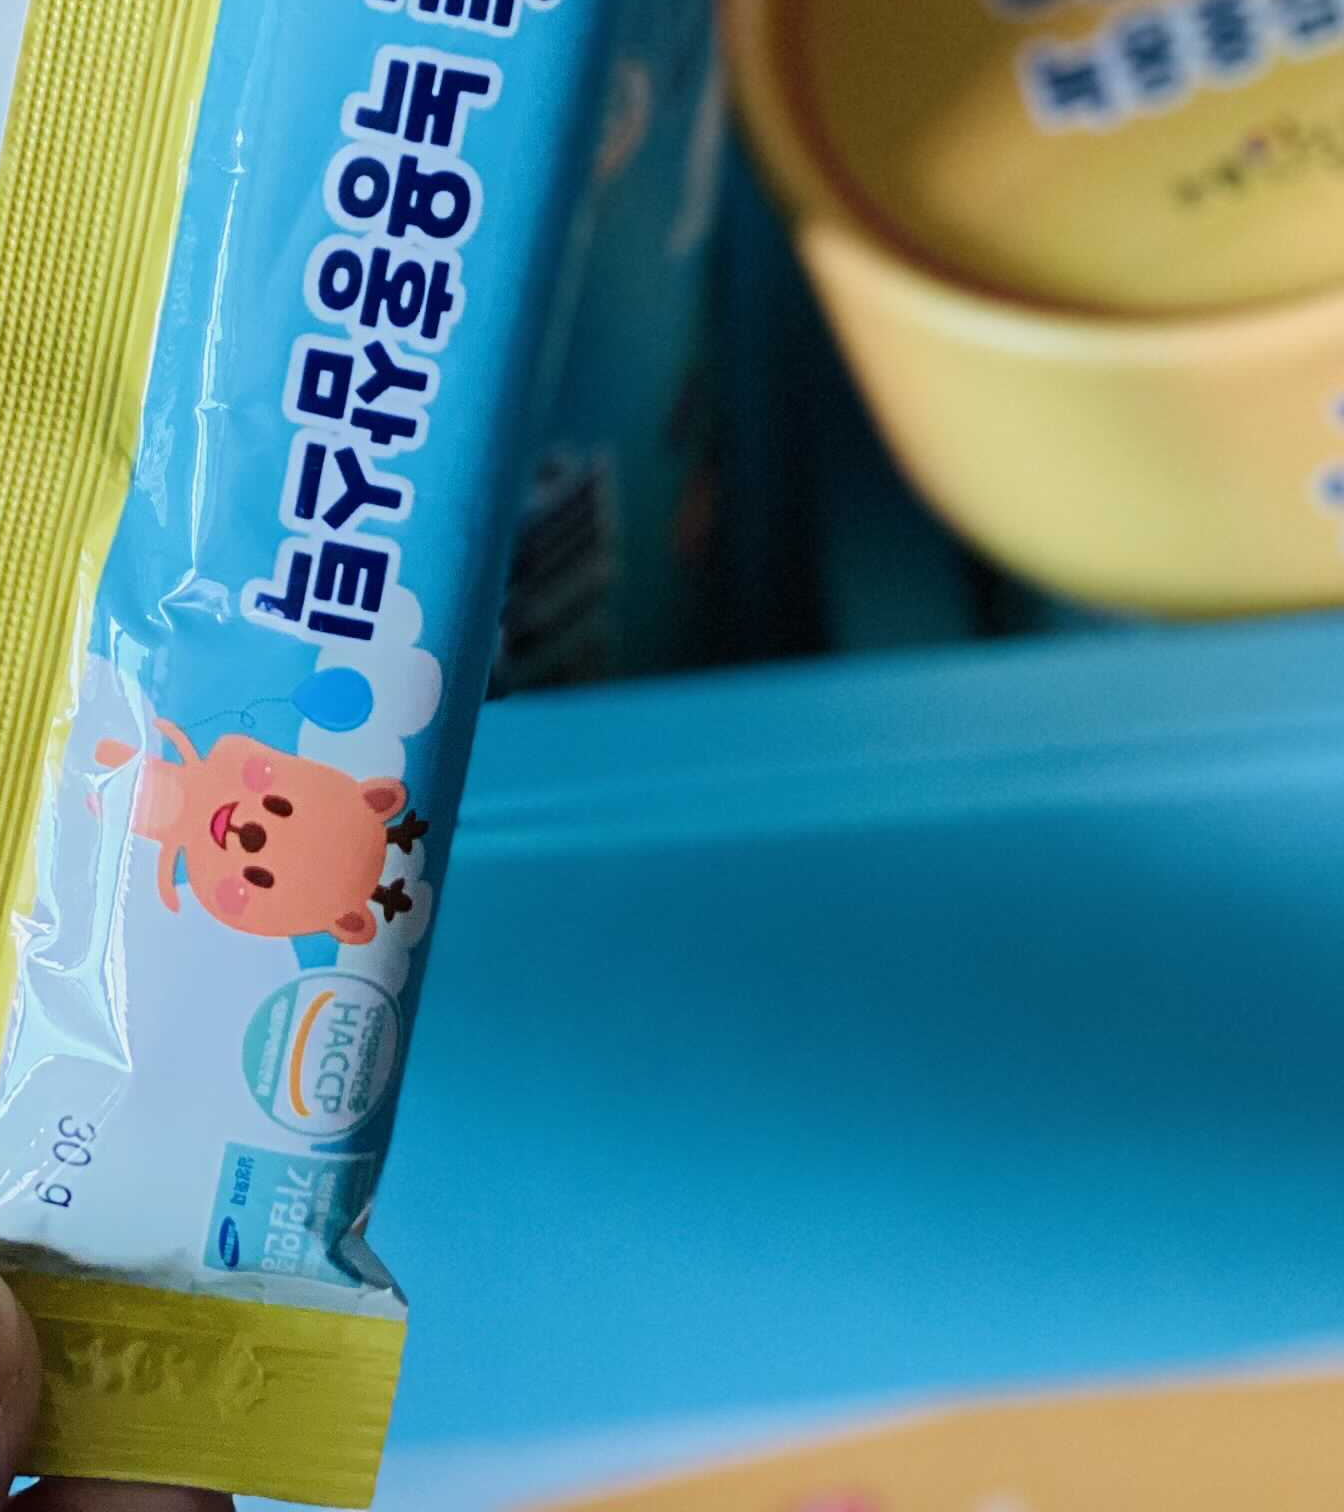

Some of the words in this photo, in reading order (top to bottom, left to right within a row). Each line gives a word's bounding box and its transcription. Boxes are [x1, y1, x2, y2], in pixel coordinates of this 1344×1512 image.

[256, 59, 490, 641] 녹용홍삼스틱
[315, 1000, 362, 1115] HACCP
[52, 1115, 96, 1167] 30
